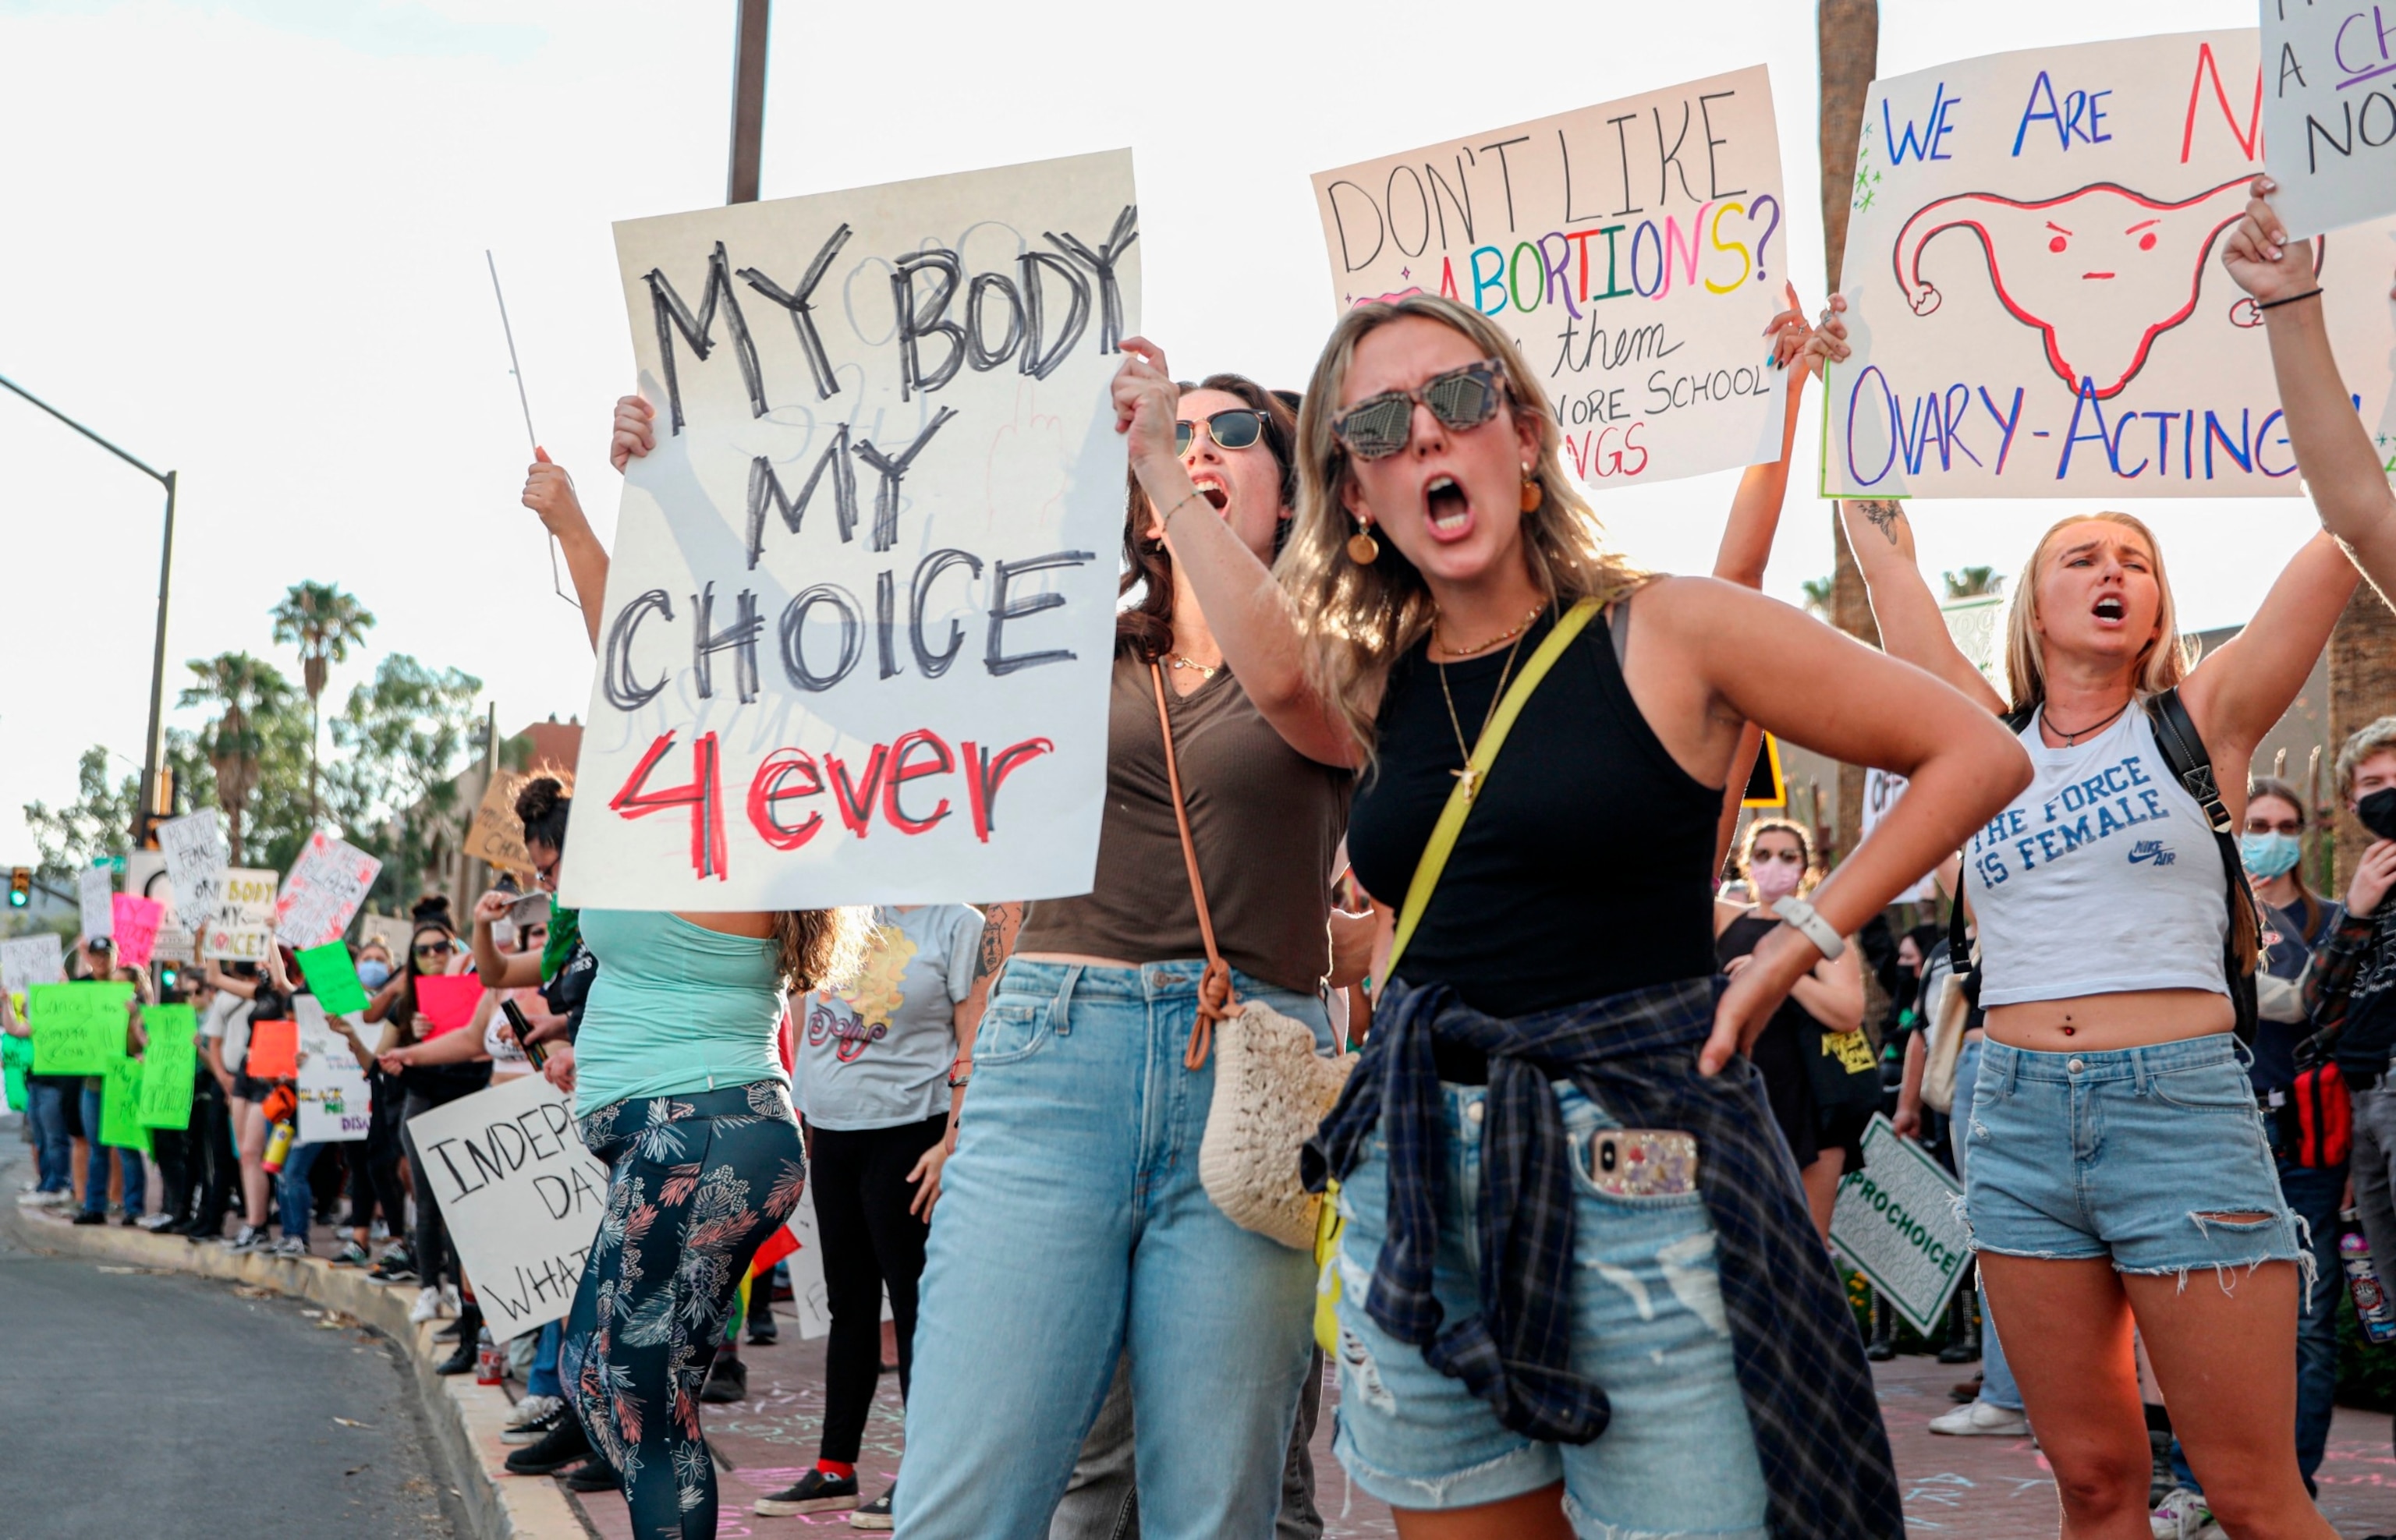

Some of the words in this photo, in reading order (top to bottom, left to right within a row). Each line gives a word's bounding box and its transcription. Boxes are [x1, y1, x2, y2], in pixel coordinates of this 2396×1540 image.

[1883, 82, 1962, 166] WE
[2011, 70, 2113, 158] ARE
[2181, 42, 2265, 165] N
[2279, 41, 2306, 97] A
[1327, 136, 1530, 274] DON'T
[1558, 90, 1748, 224] LIKE
[1438, 193, 1781, 320] ABORTIONS?
[640, 221, 853, 437] MY
[889, 204, 1140, 403] BODY
[1550, 308, 1685, 378] them
[1644, 365, 1770, 415] SCHOOL
[747, 405, 960, 572] MY
[601, 547, 1097, 713] CHOICE
[2043, 755, 2153, 823] FORCE
[1975, 851, 2010, 890] IS
[2015, 788, 2171, 872] FEMALE
[2132, 840, 2165, 855] NIKE
[2152, 852, 2177, 867] AIR
[219, 905, 243, 927] MY
[229, 879, 277, 904] BODY
[808, 1003, 888, 1063] Dolly
[1846, 1170, 1958, 1276] PROCHOICE
